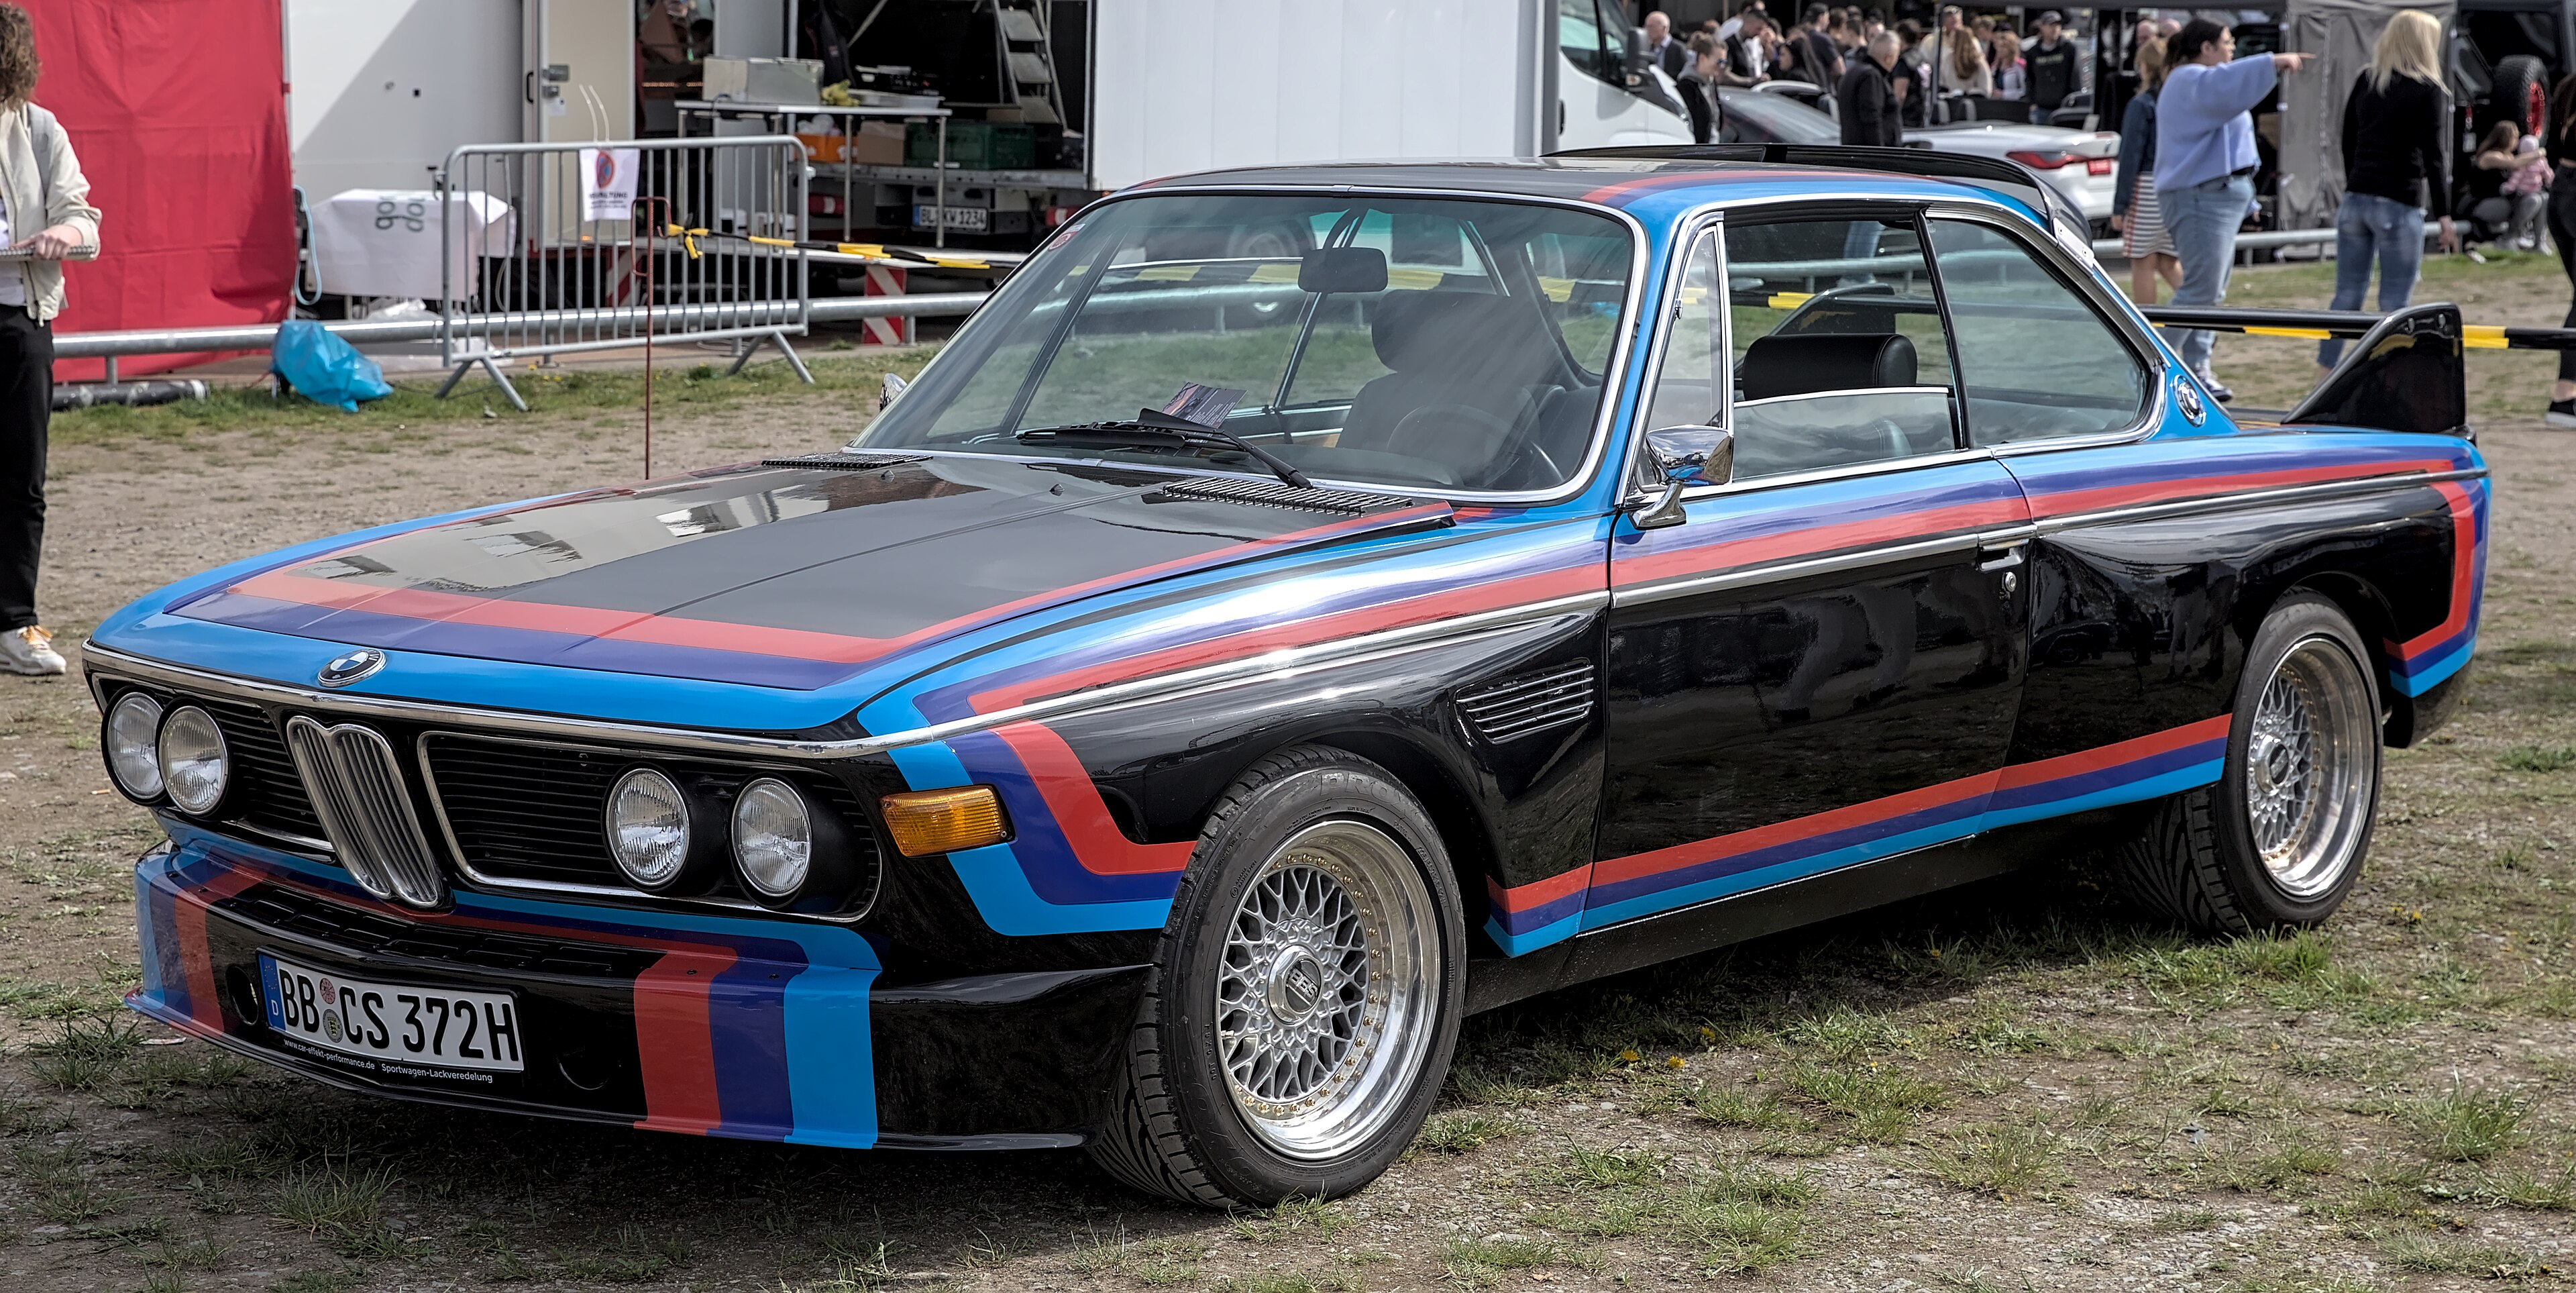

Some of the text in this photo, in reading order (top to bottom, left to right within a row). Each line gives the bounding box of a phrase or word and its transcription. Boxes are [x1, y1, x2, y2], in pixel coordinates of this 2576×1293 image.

[1289, 968, 1318, 998] BBS
[272, 1000, 278, 1015] D
[279, 969, 320, 1032] BB
[339, 986, 390, 1049] CS
[398, 994, 519, 1061] 372H
[284, 1039, 492, 1083] www.car-effekt-performance.de Sportwagen-Lackveredelung
